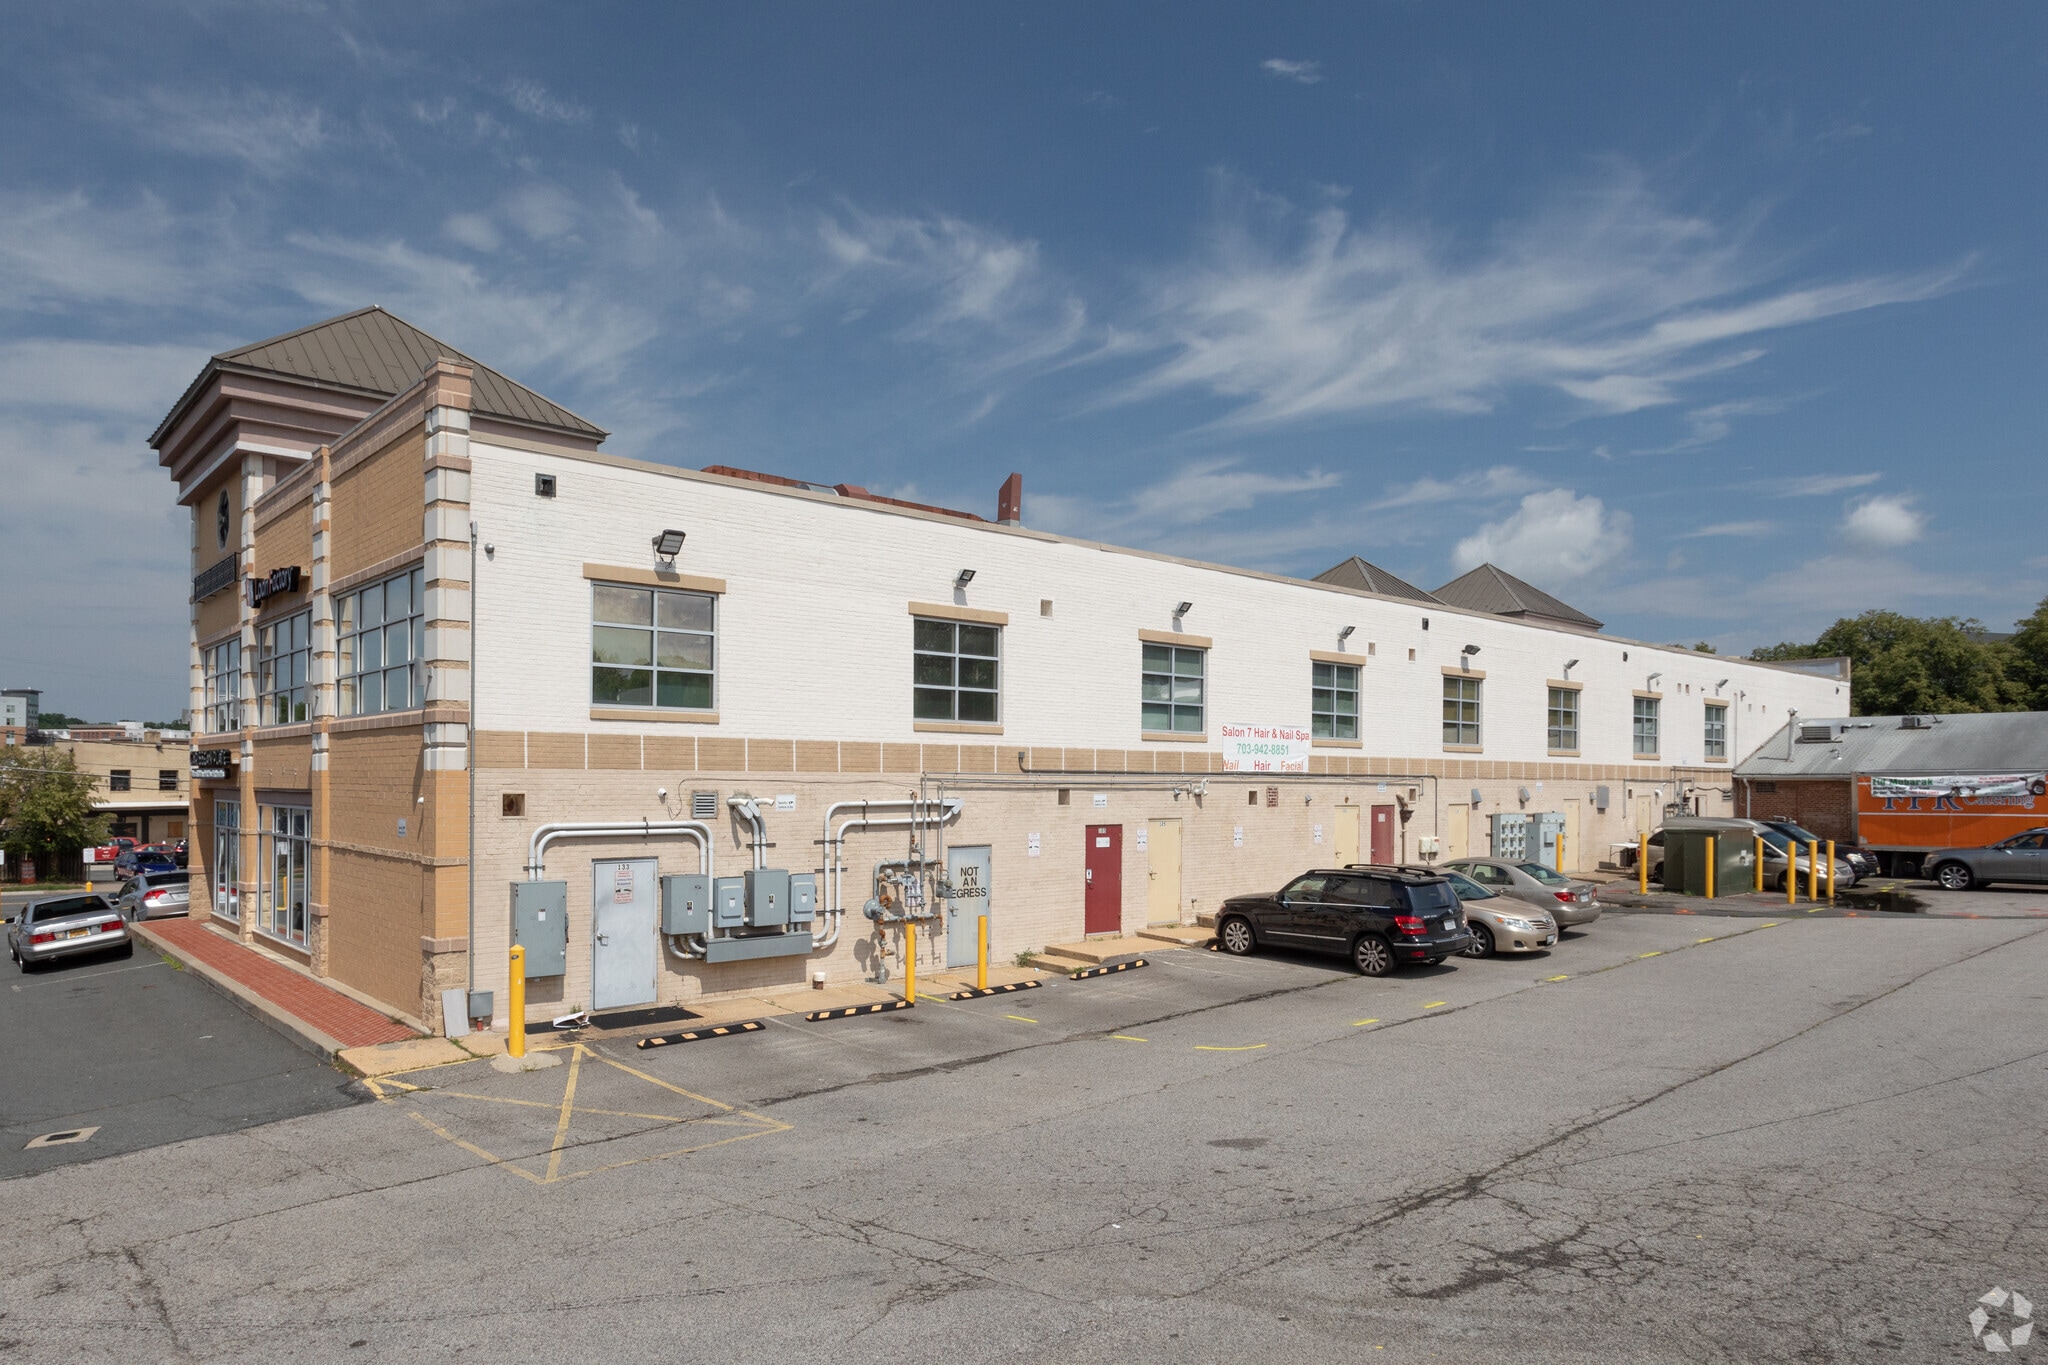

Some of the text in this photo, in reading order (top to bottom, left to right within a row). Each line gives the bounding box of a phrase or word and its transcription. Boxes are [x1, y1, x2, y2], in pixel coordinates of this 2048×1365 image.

[254, 567, 293, 601] Loan Factory
[1222, 725, 1310, 742] Salon 7 Hair & Nail Spa
[1237, 743, 1289, 755] 703-942-8851
[1222, 759, 1304, 771] Nail Hair Facial
[617, 863, 630, 871] 133
[960, 866, 979, 877] NOT
[962, 877, 978, 887] AN
[951, 887, 987, 899] EGRESS
